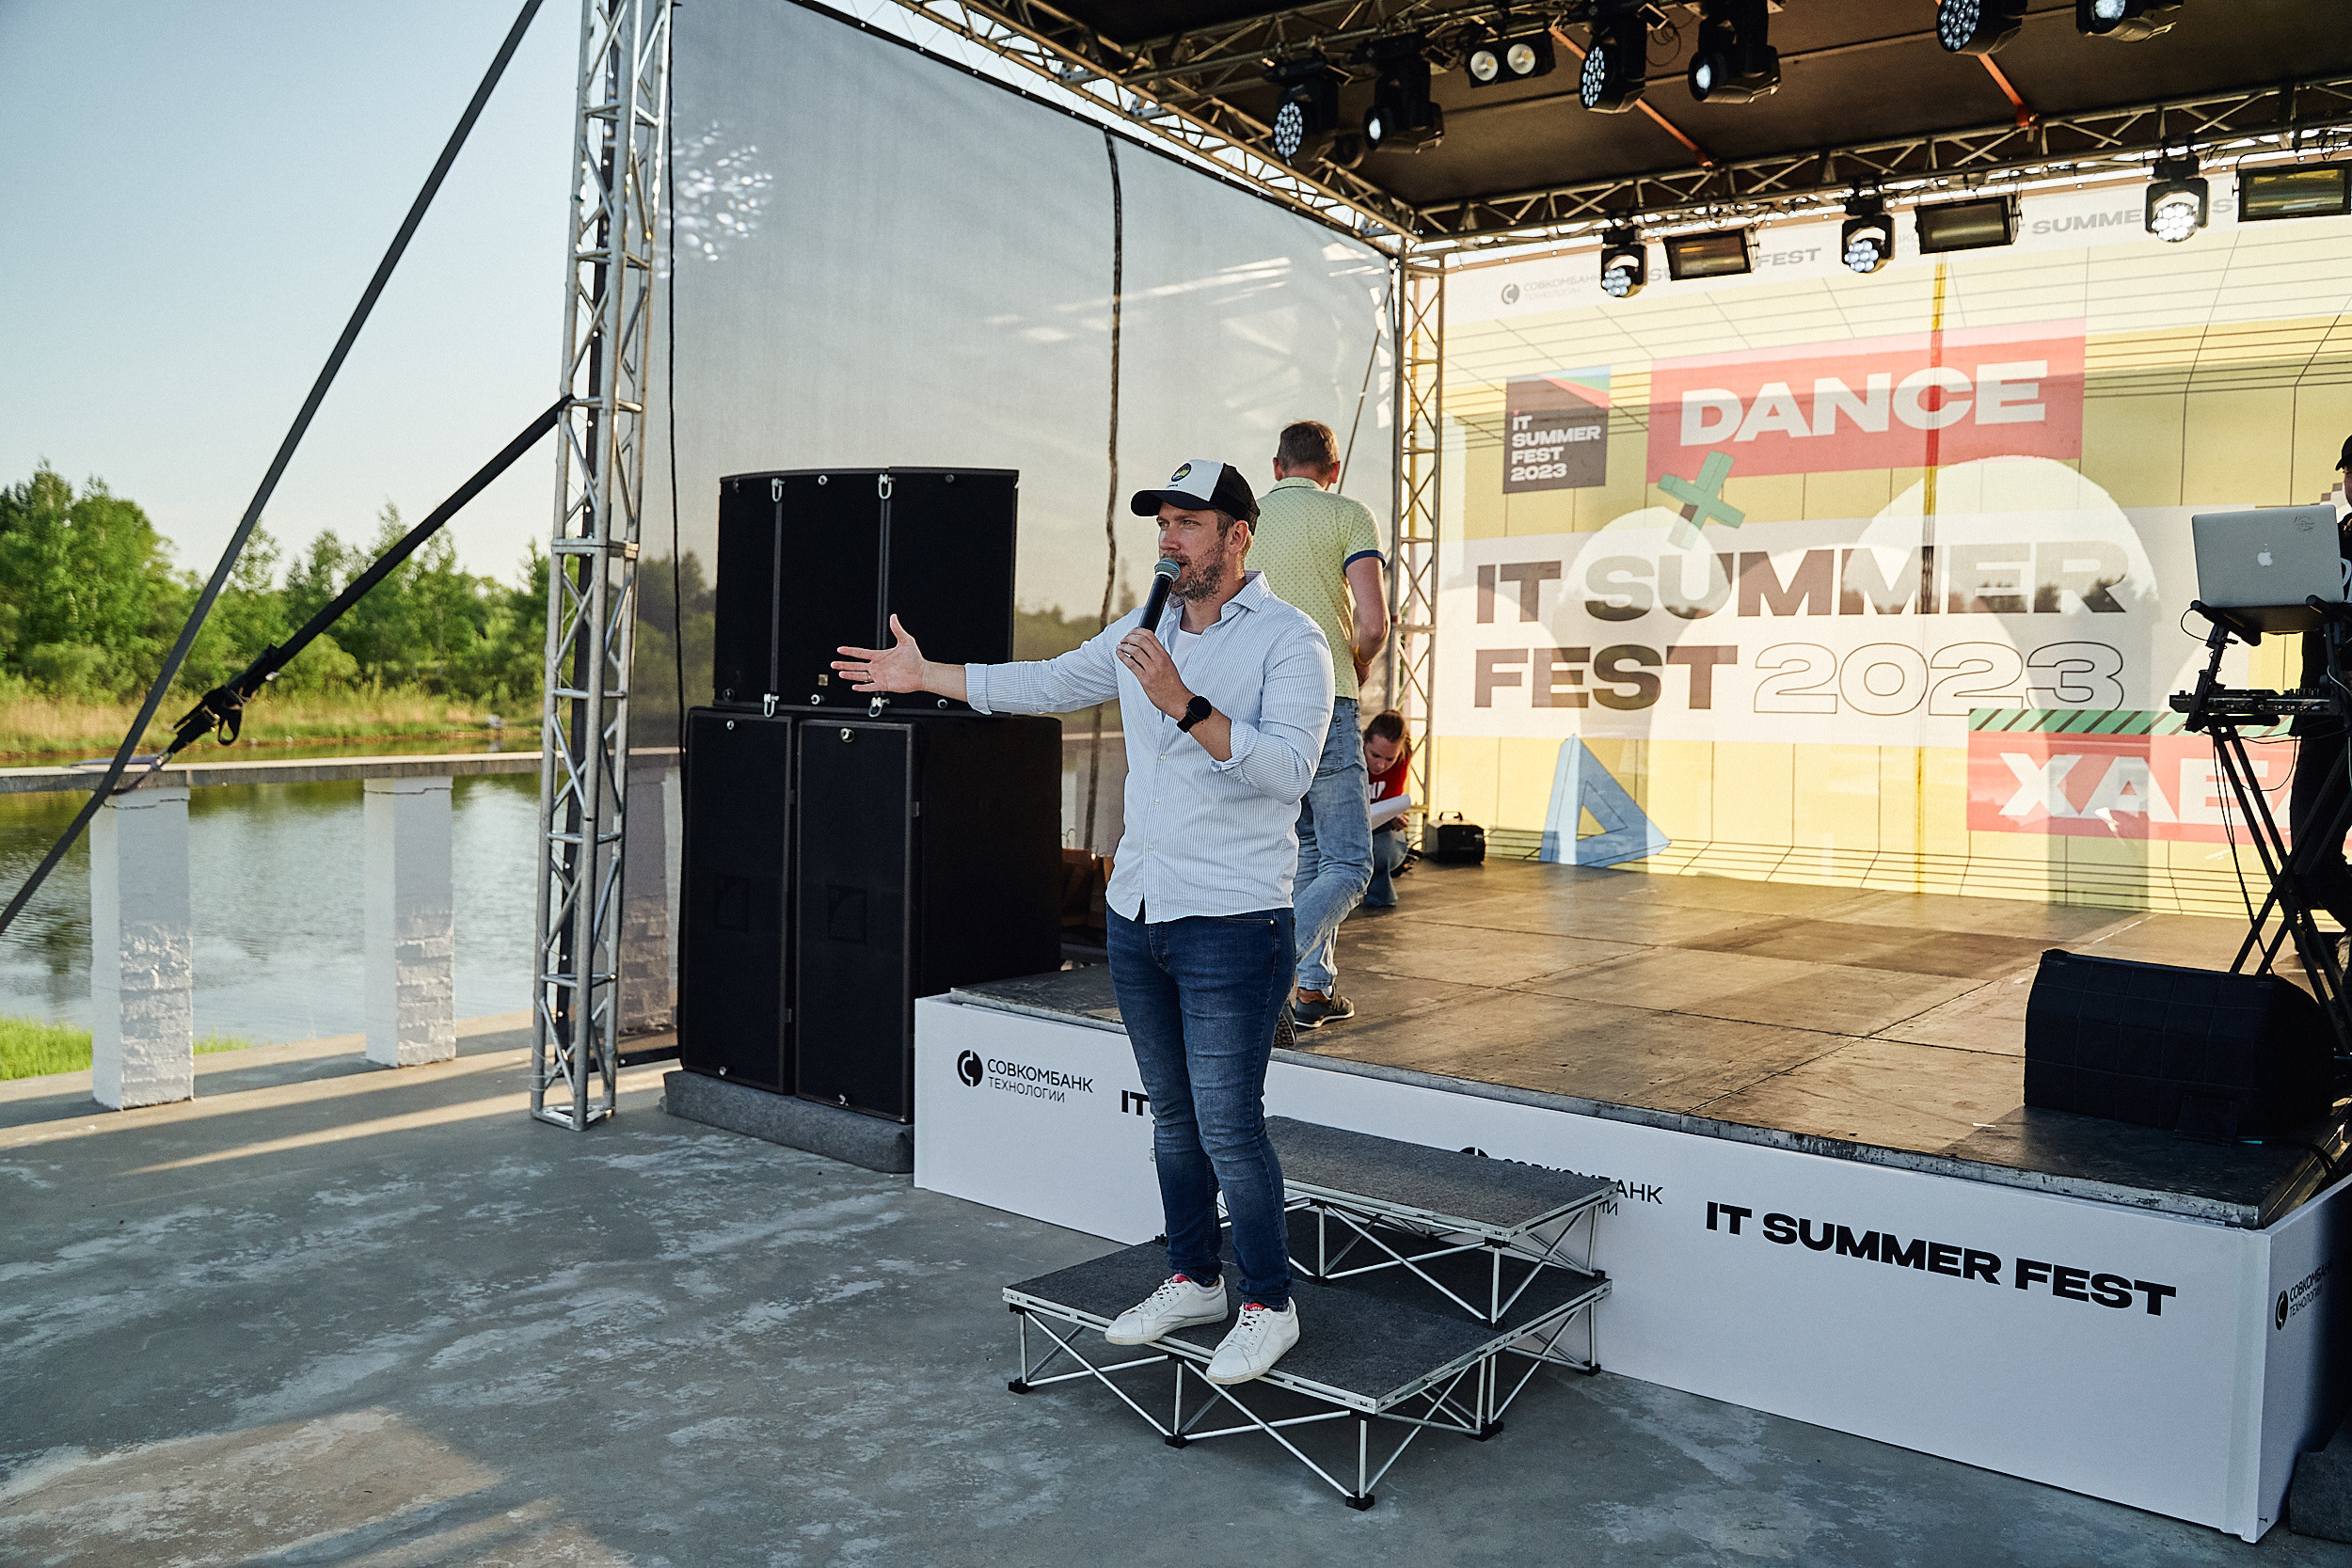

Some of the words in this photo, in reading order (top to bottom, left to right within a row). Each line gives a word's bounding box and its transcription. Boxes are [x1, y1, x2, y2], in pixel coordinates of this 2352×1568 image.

[2032, 208, 2142, 235] SUMME
[1757, 247, 1821, 268] FEST
[1680, 359, 2048, 446] DANCE
[1511, 425, 1601, 448] SUMMER
[1512, 415, 1533, 431] IT
[1511, 446, 1565, 465] FEST
[1510, 463, 1567, 482] 2023
[1477, 561, 1562, 624] IT
[1585, 541, 2129, 622] SUMMER
[1474, 643, 1739, 710] FEST
[1754, 641, 2124, 716] 2023
[1998, 752, 2293, 830] ХАБ
[987, 1058, 1093, 1094] СОВКОМБАНК
[988, 1076, 1065, 1103] ТЕХНОЛОГИИ
[1121, 1089, 1150, 1117] IT
[1706, 1201, 1752, 1235] IT
[1762, 1212, 2002, 1285] SUMMER
[2015, 1257, 2177, 1317] FEST
